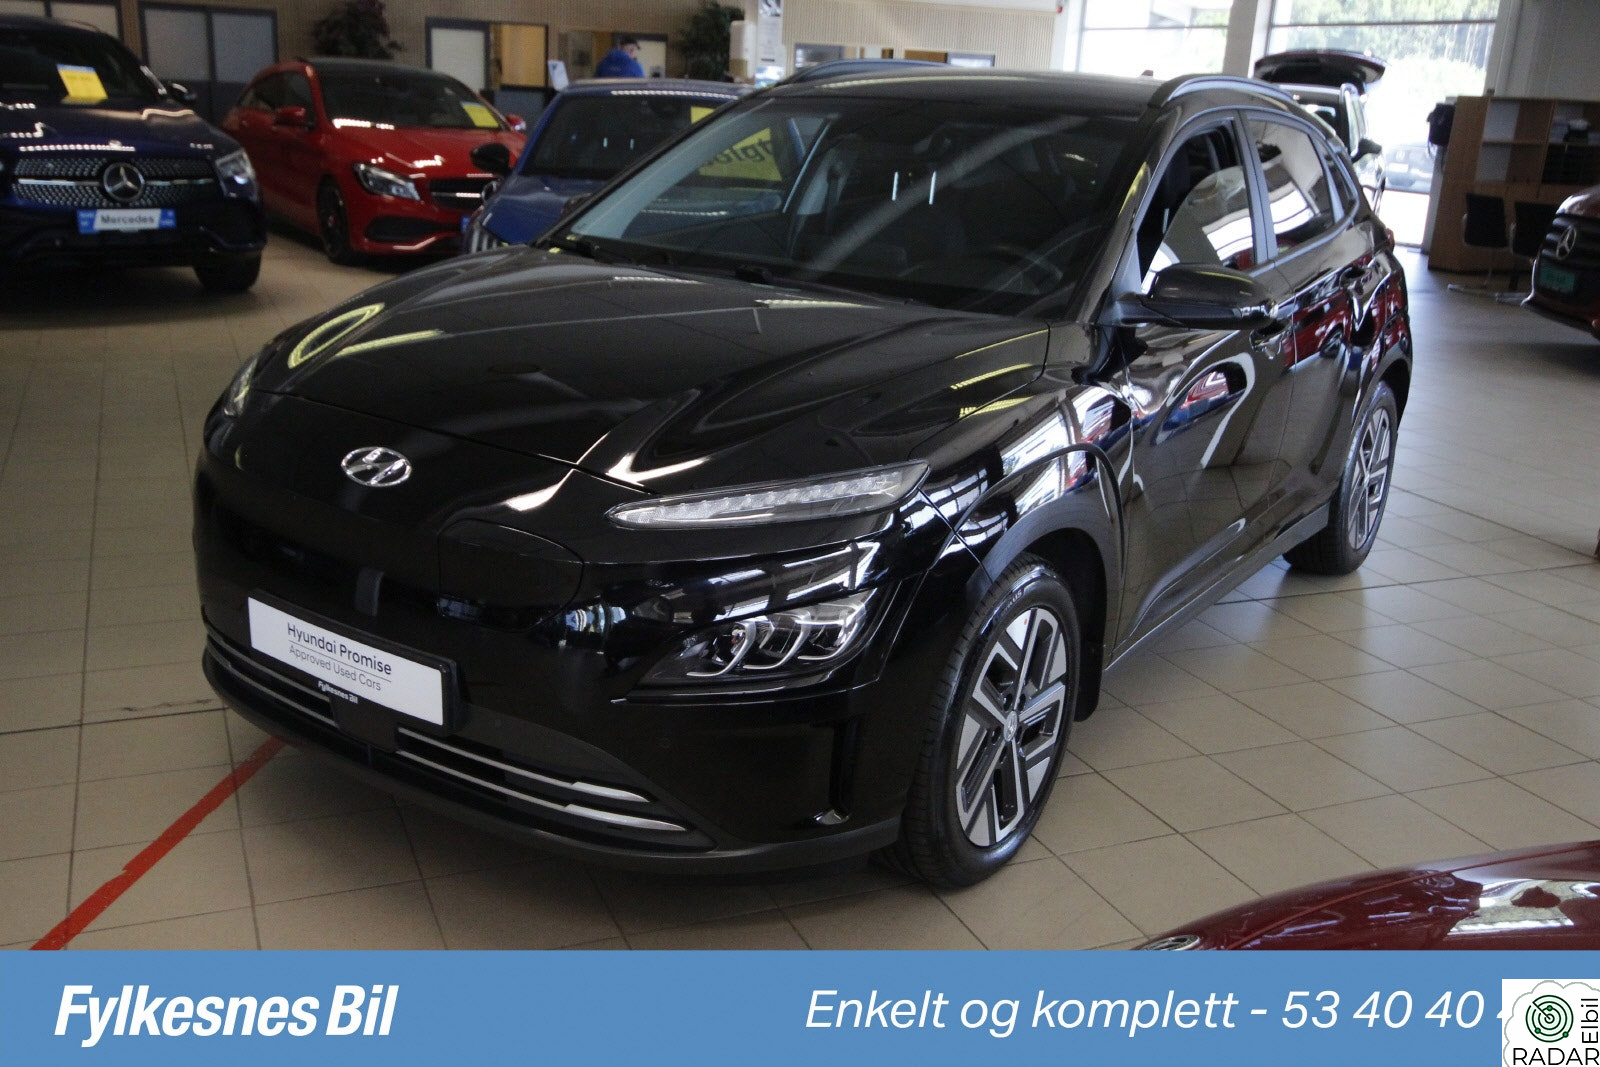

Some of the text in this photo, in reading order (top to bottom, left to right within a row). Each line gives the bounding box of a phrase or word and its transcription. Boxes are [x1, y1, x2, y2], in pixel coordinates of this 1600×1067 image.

[101, 214, 155, 224] Mercedes
[287, 622, 392, 675] Hyundai Promise
[289, 645, 382, 691] Approved Used Cars
